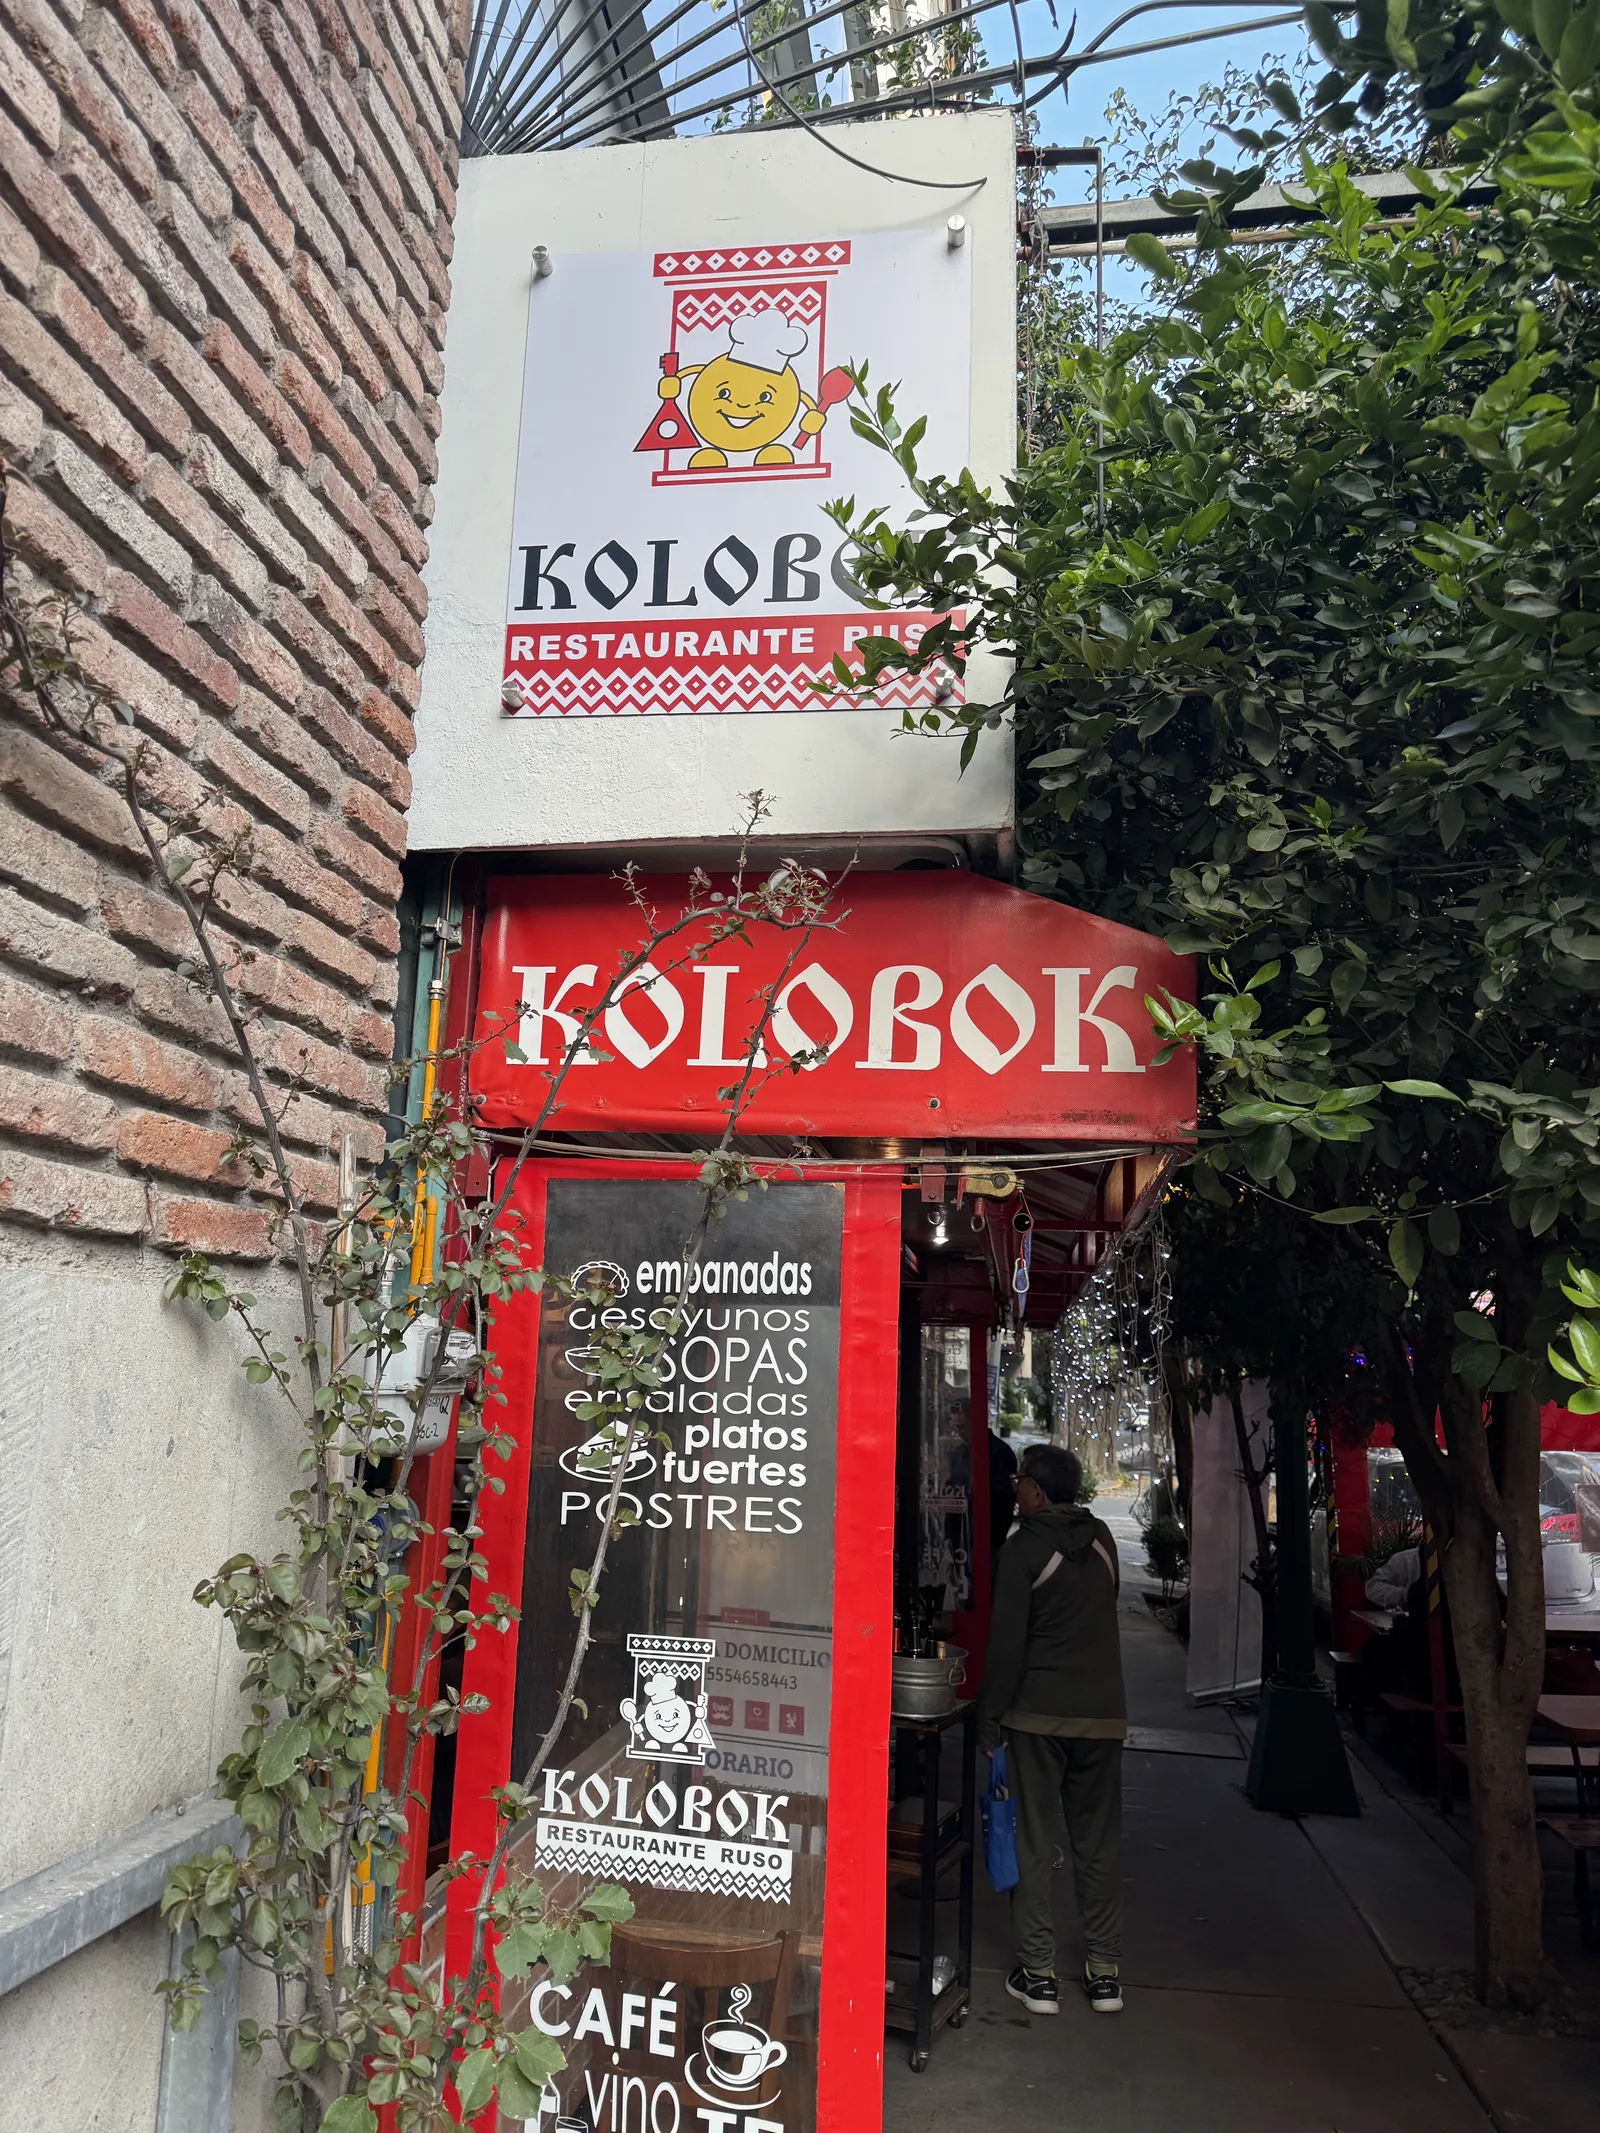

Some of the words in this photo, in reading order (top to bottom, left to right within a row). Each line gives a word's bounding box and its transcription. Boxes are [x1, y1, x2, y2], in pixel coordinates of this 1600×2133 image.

[514, 532, 956, 611] KOLOBO
[510, 627, 814, 661] RESTAURANTE
[505, 961, 1146, 1075] KOLOBOK
[636, 1251, 812, 1304] empanadas
[652, 1335, 808, 1385] SOPAS
[684, 1418, 808, 1455] platos
[662, 1451, 807, 1487] fuertes
[560, 1491, 803, 1534] POSTRES
[724, 1641, 831, 1668] DOMICILIO
[539, 1767, 790, 1843] KOLOBOK
[546, 1824, 706, 1860] RESTAURANTE
[720, 1848, 783, 1870] RUSO
[529, 1980, 677, 2058] CAFÉ
[584, 2052, 681, 2133] vino
